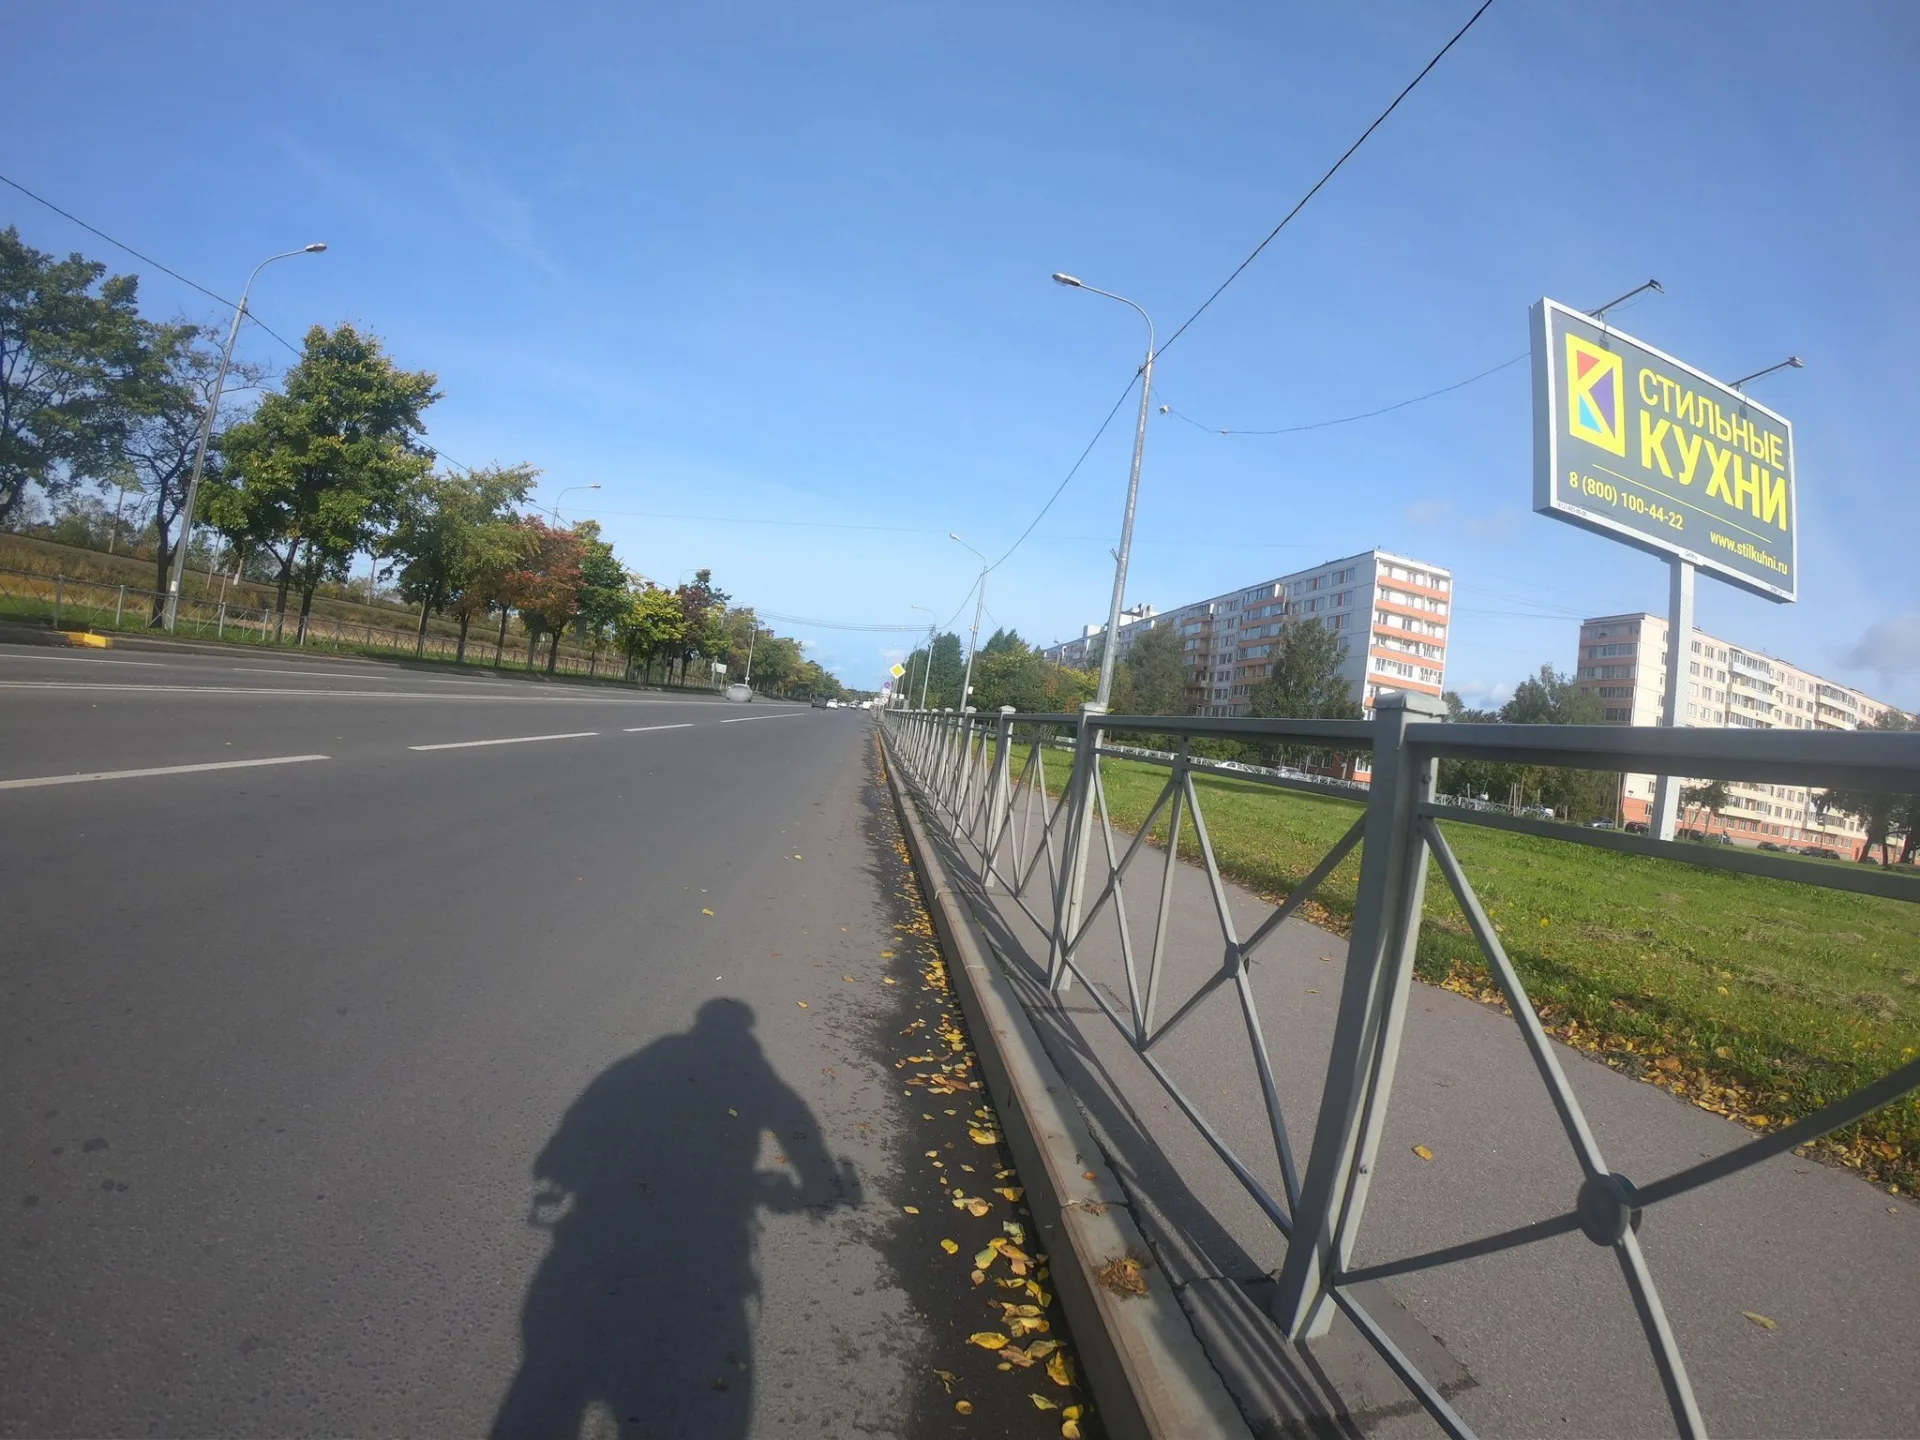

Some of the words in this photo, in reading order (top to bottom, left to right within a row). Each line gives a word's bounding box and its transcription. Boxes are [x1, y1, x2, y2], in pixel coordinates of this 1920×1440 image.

[1638, 367, 1784, 471] СТИЛЬНЫЕ
[1569, 471, 1579, 488] 8
[1582, 475, 1618, 507] (800)
[1621, 492, 1684, 531] 100-44-22
[1639, 408, 1787, 531] КУХНИ
[1710, 531, 1788, 575] www.stilkuhni.ru
